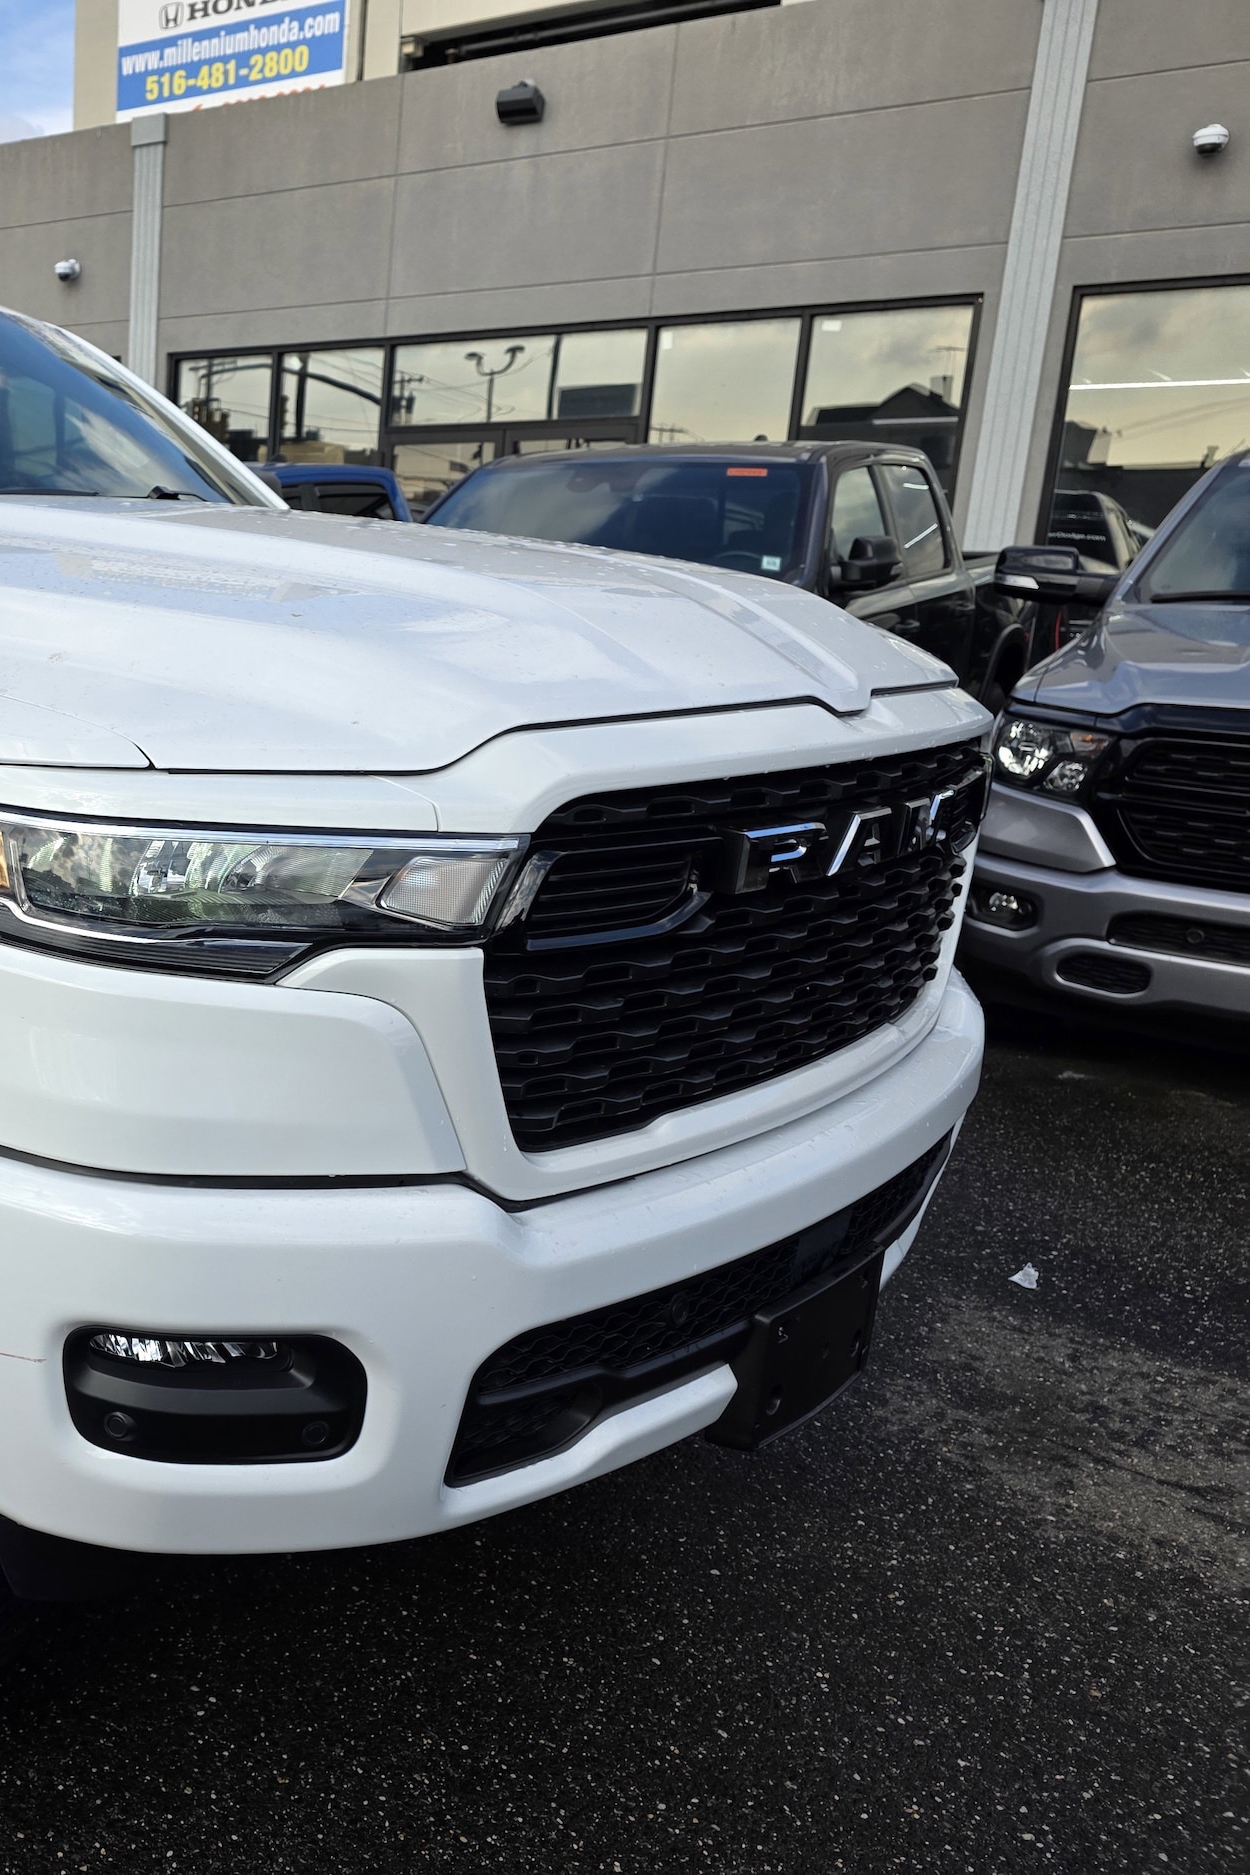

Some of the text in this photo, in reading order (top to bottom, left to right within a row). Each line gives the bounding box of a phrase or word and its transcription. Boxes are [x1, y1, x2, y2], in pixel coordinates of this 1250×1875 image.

[188, 0, 287, 20] HON
[121, 11, 340, 76] www.millenniumhonda.com
[145, 45, 309, 100] 516-481-2800
[733, 788, 955, 894] RAM
